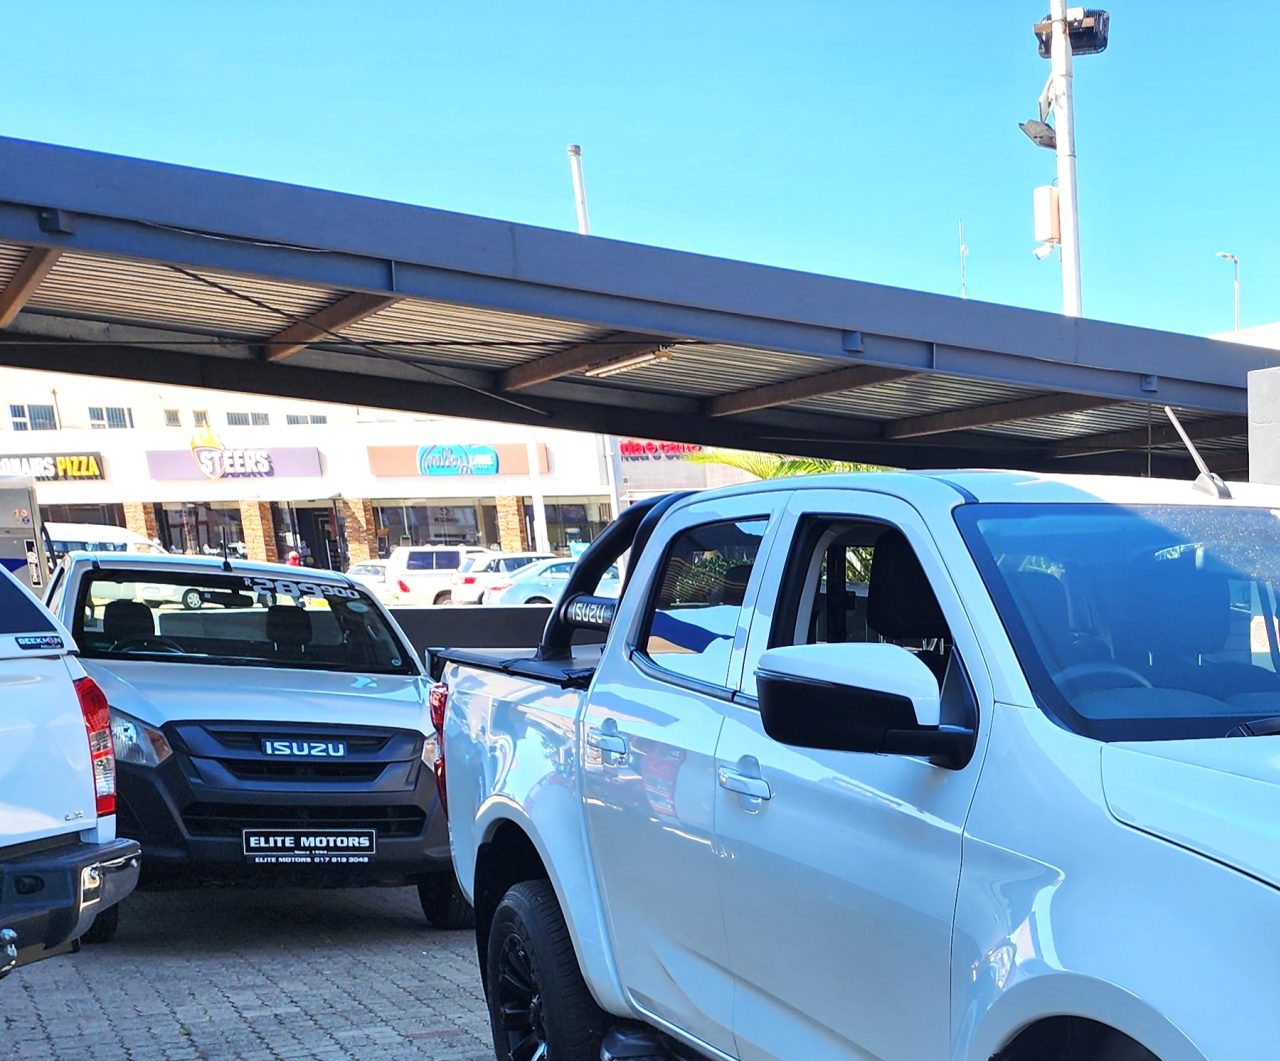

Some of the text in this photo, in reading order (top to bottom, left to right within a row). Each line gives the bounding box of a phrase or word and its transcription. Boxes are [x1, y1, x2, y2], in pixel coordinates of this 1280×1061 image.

[56, 456, 100, 476] PIZZA
[200, 450, 270, 475] STEERS
[572, 602, 606, 624] ISUZU
[265, 741, 344, 756] ISUZU
[249, 836, 370, 848] ELITE MOTORS
